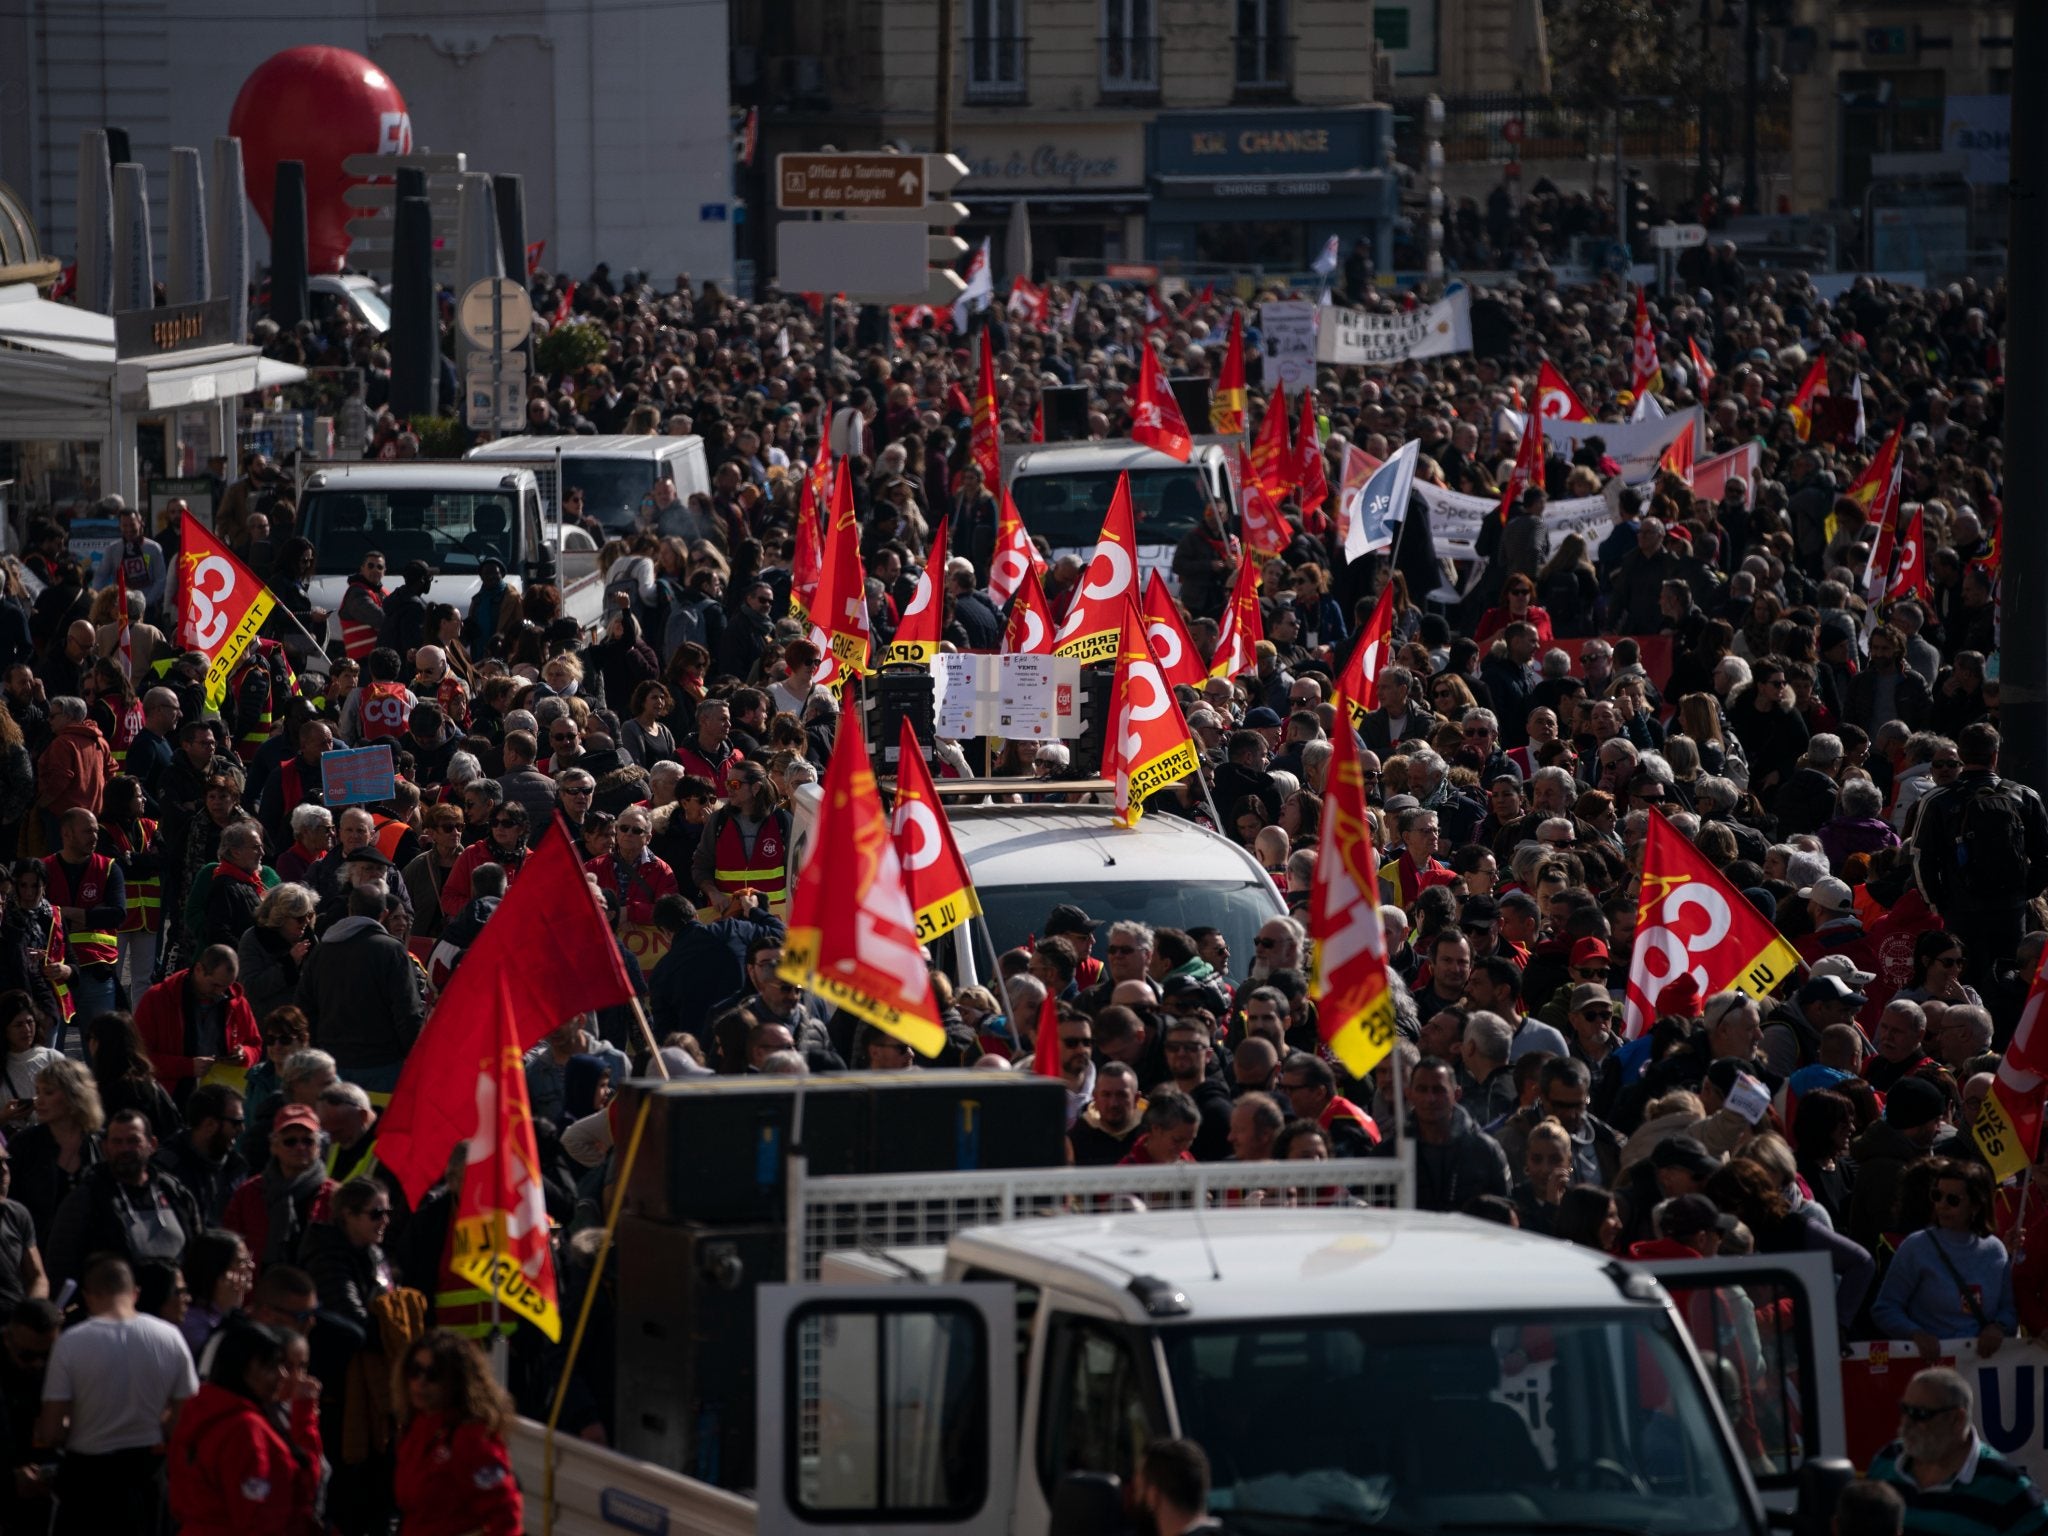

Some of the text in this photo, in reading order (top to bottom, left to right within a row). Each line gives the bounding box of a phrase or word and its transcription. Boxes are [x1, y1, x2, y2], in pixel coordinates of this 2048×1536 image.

[1238, 129, 1329, 154] CHANGE
[808, 164, 896, 178] Office du Tourisme
[808, 185, 887, 202] et des Congrès
[1214, 182, 1268, 196] CHANGE
[1057, 694, 1071, 704] cgt
[763, 844, 776, 853] cgt
